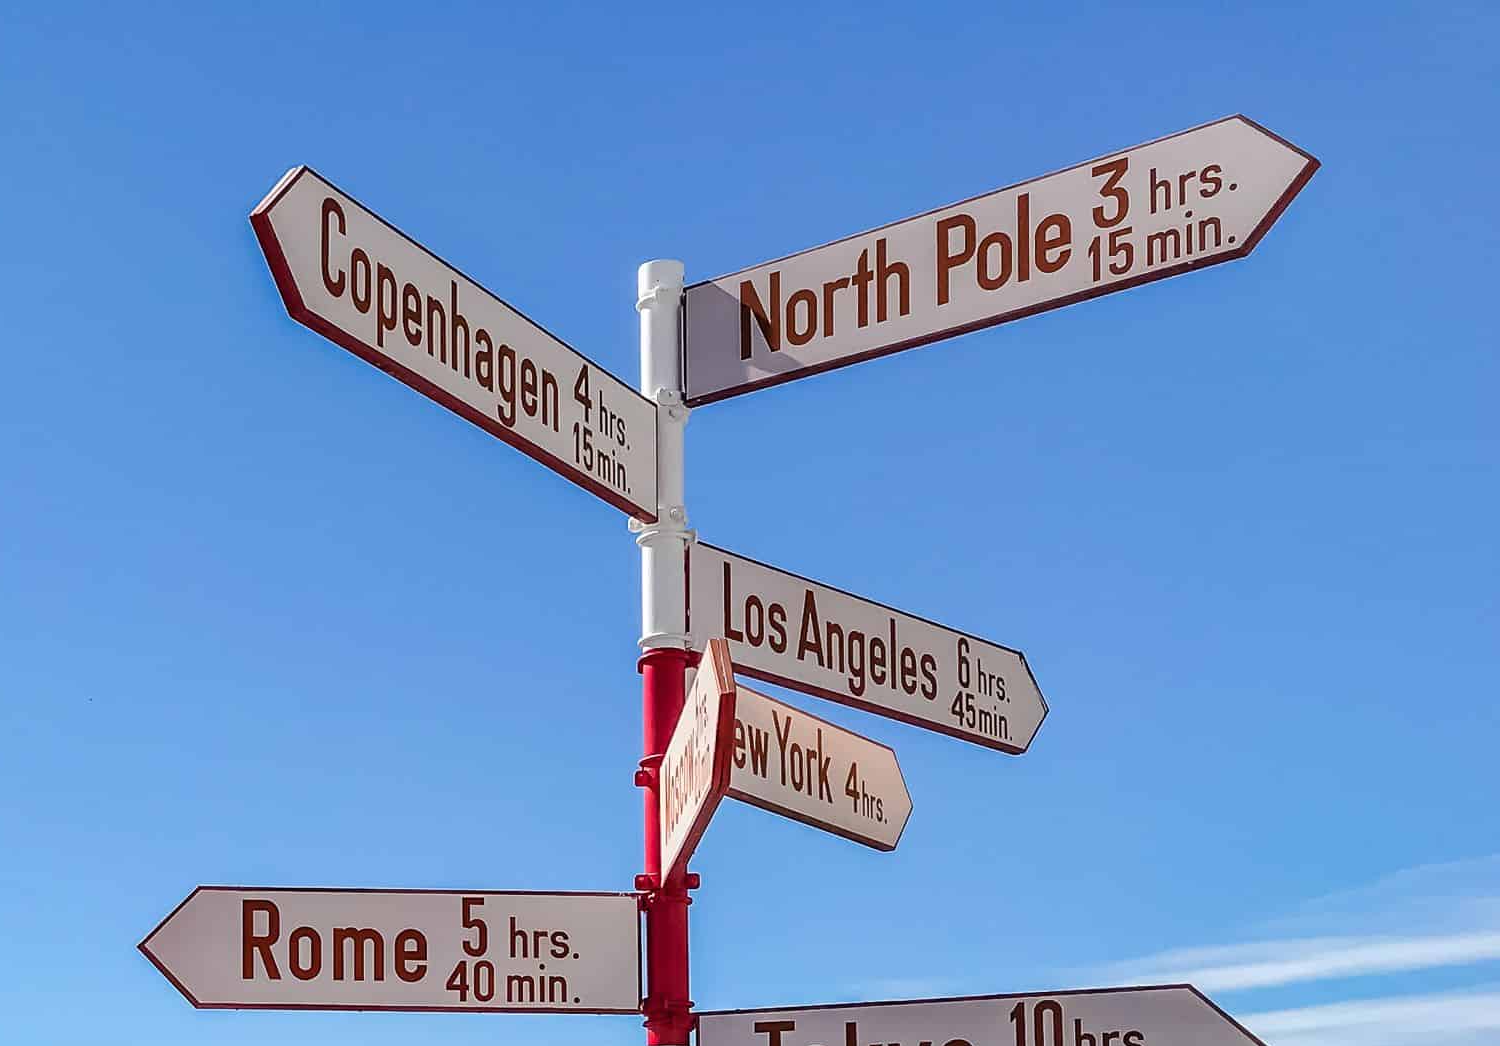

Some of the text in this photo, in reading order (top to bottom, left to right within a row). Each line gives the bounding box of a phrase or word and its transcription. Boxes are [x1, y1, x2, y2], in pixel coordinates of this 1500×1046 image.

[740, 157, 1238, 361] North Pole 3 hrs.
[1088, 210, 1237, 282] 15 min.
[320, 197, 631, 451] Copenhagen 4 hrs.
[573, 421, 631, 493] 15 min.
[723, 561, 1010, 703] Los Angeles 6 hrs.
[951, 694, 1013, 741] 45 min.
[733, 717, 769, 779] ew
[772, 709, 833, 804] York
[845, 762, 860, 813] 4
[862, 780, 888, 824] hrs.
[242, 897, 580, 983] Rome 5 hrs.
[445, 960, 580, 1004] 40 min.
